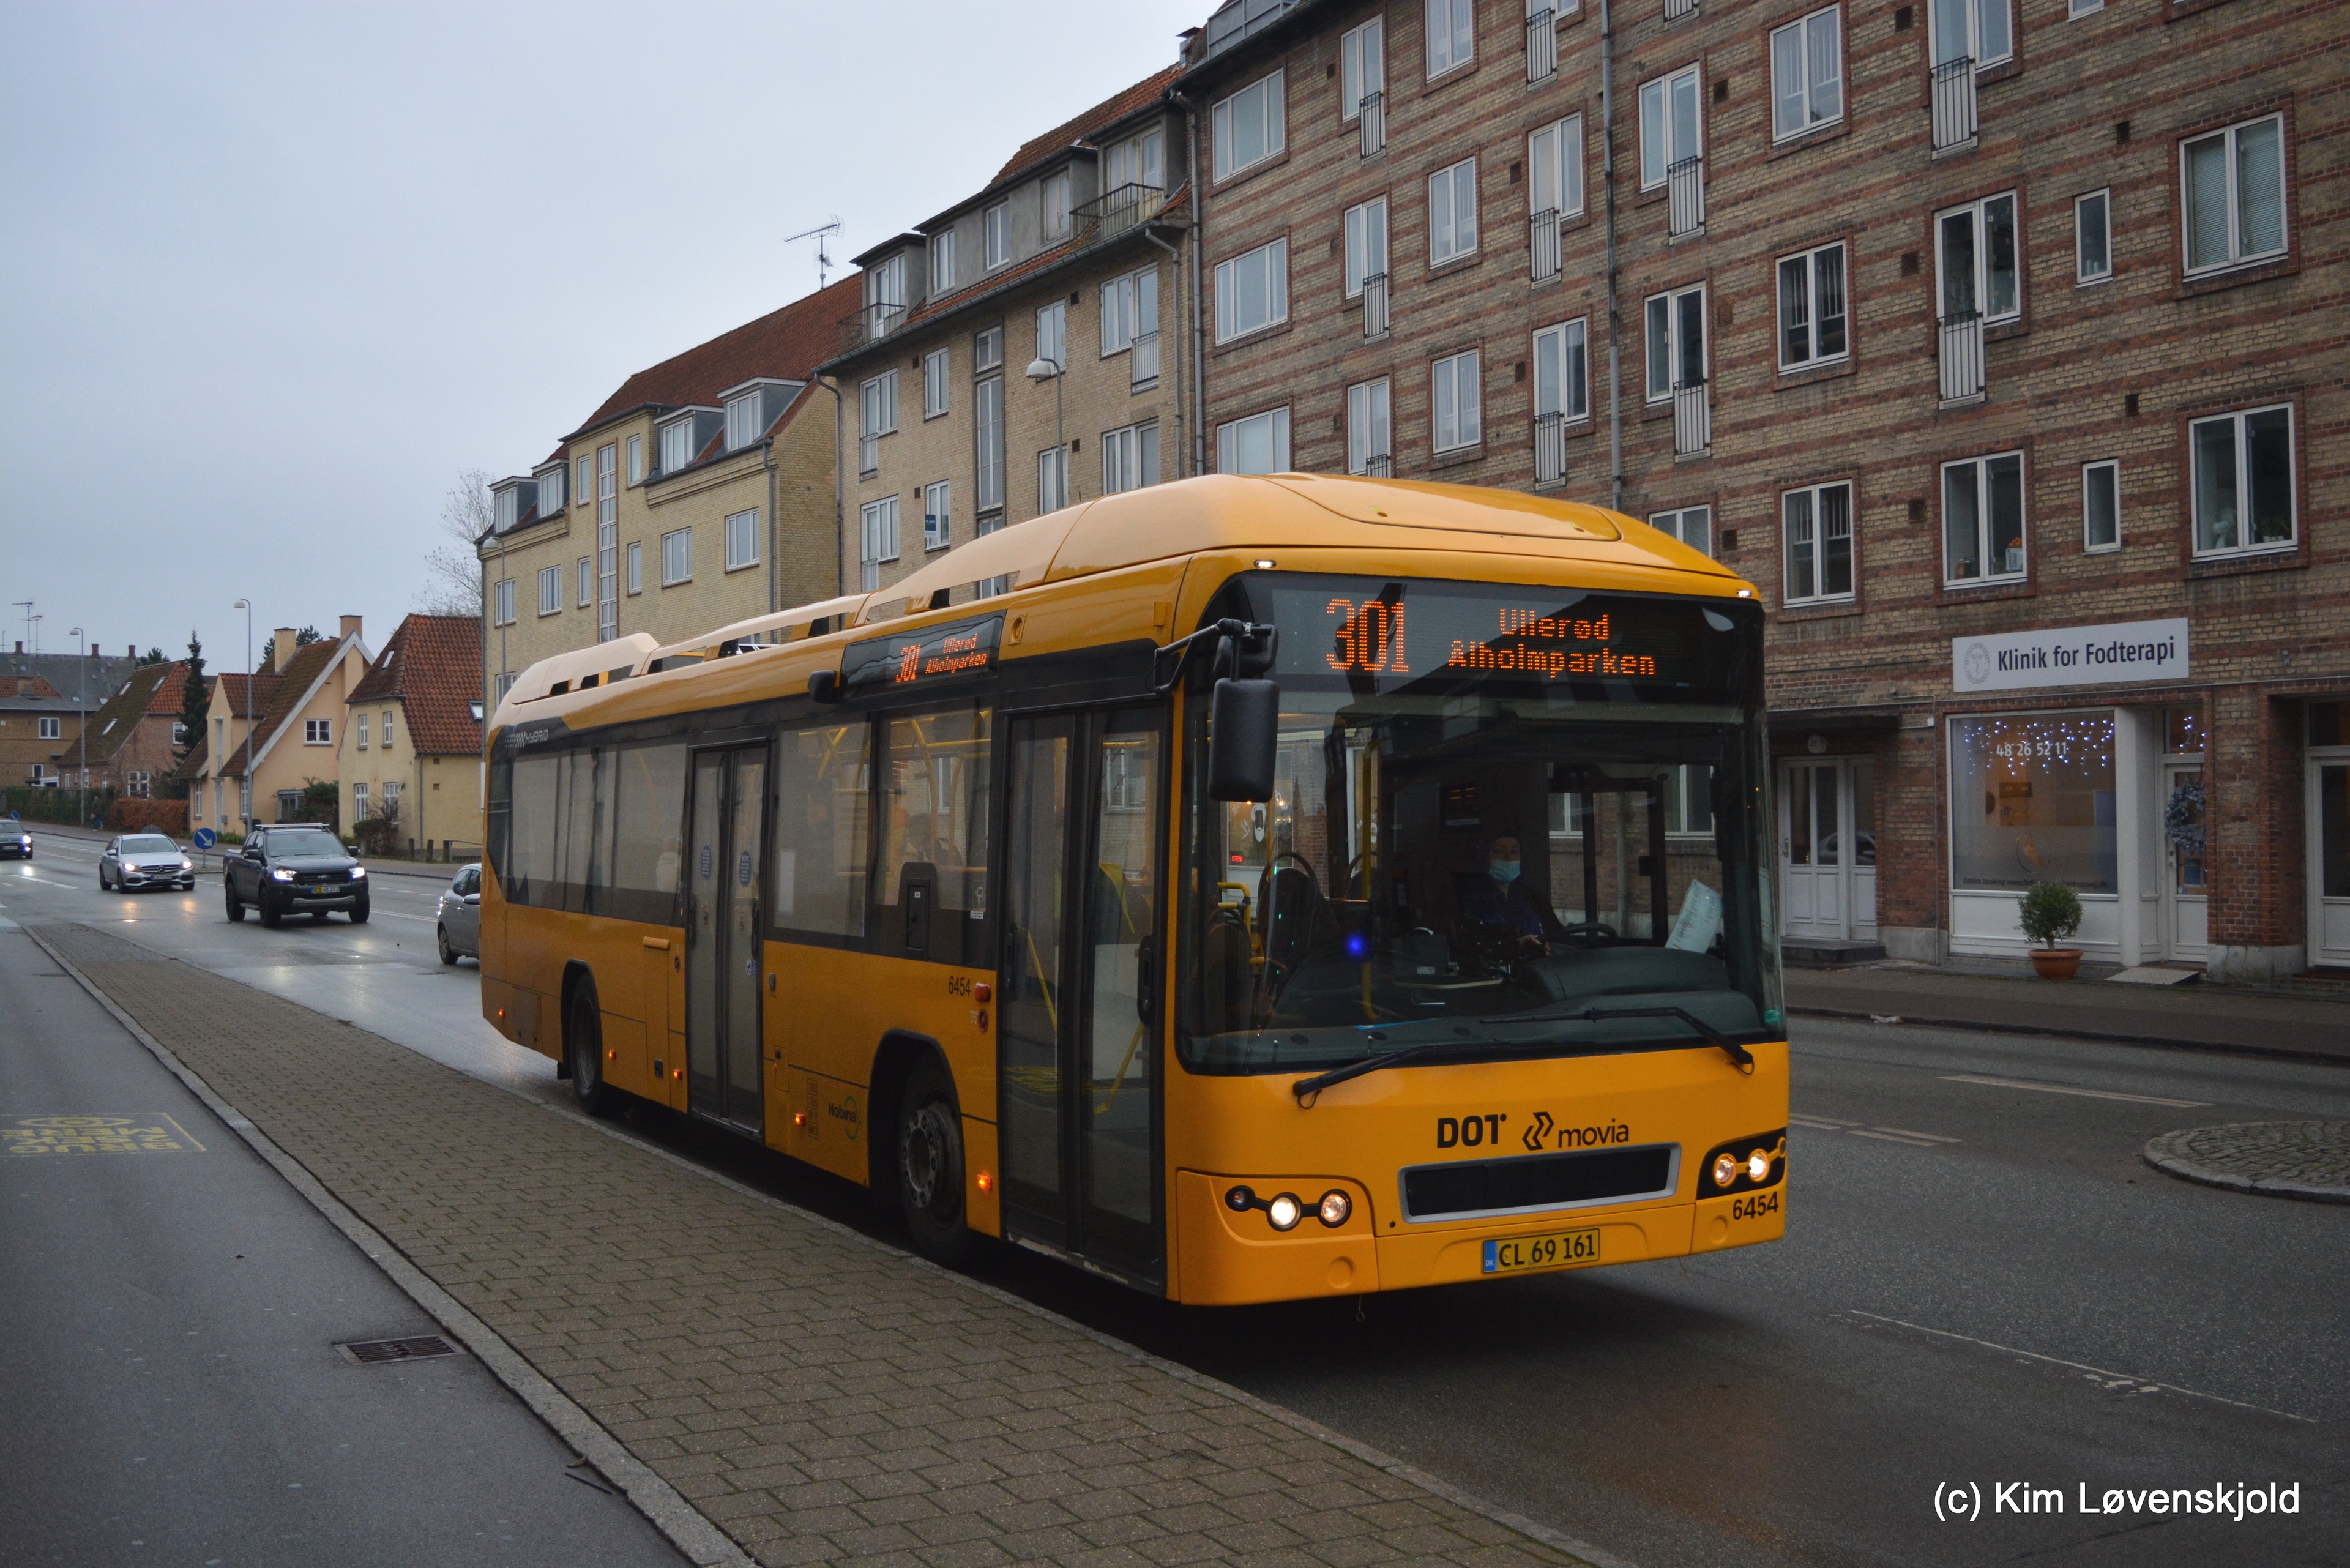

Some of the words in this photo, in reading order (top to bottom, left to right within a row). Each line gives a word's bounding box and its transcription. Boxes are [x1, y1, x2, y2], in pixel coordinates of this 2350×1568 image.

[1326, 598, 1409, 673] 301
[1499, 608, 1609, 640] Ullerød
[895, 644, 921, 682] 301
[1997, 648, 2047, 671] Klinik
[2053, 646, 2079, 667] for
[2086, 635, 2174, 665] Fodterapi
[525, 729, 548, 744] HYBRID
[1996, 744, 2012, 756] 48
[2017, 742, 2032, 756] 26
[2037, 742, 2051, 756] 52
[2055, 742, 2067, 755] 11
[948, 975, 971, 997] 6454
[828, 1102, 857, 1124] Nobina
[1436, 1113, 1507, 1149] DOT
[1558, 1118, 1629, 1148] movia
[1733, 1191, 1778, 1220] 6454
[1485, 1258, 1494, 1267] DK
[1499, 1243, 1525, 1267] CL
[1532, 1239, 1556, 1263] 69
[1563, 1234, 1595, 1260] 161
